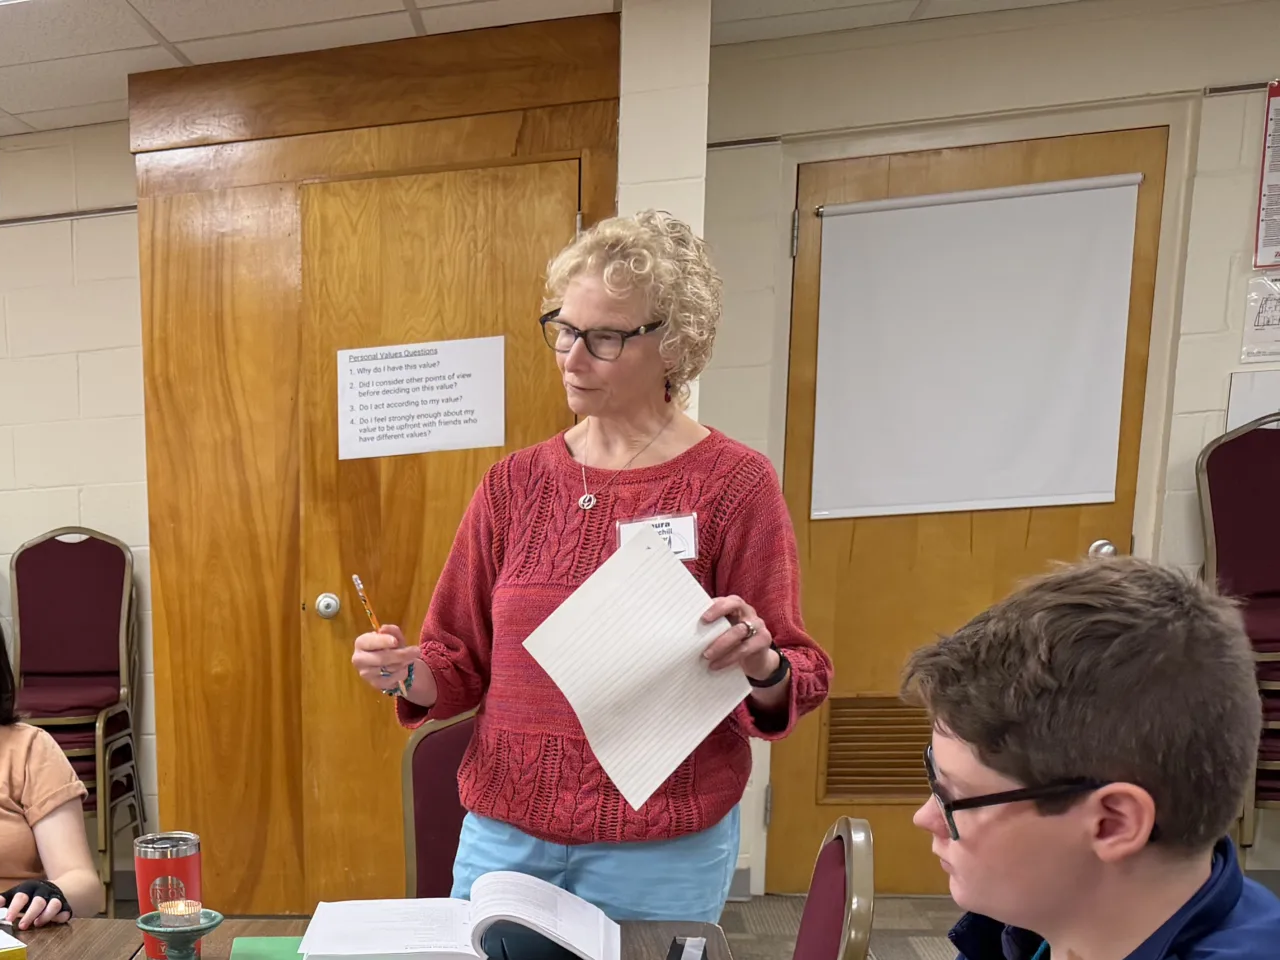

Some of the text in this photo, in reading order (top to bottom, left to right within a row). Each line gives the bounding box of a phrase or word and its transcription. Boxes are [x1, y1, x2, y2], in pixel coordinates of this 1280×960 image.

[349, 348, 438, 362] Personal Values Questions
[357, 367, 371, 375] Why
[419, 361, 440, 369] value?
[376, 378, 404, 386] consider
[406, 376, 423, 384] other
[425, 374, 446, 384] points
[359, 388, 380, 397] before
[382, 386, 410, 396] deciding
[436, 382, 457, 390] value?
[387, 400, 419, 408] according
[374, 415, 387, 423] feel
[389, 413, 415, 422] strongly
[417, 411, 441, 420] enough
[443, 409, 462, 417] about
[396, 421, 420, 431] upfront
[422, 420, 436, 428] with
[438, 418, 461, 427] friends
[377, 432, 404, 441] different
[406, 430, 431, 438] values?
